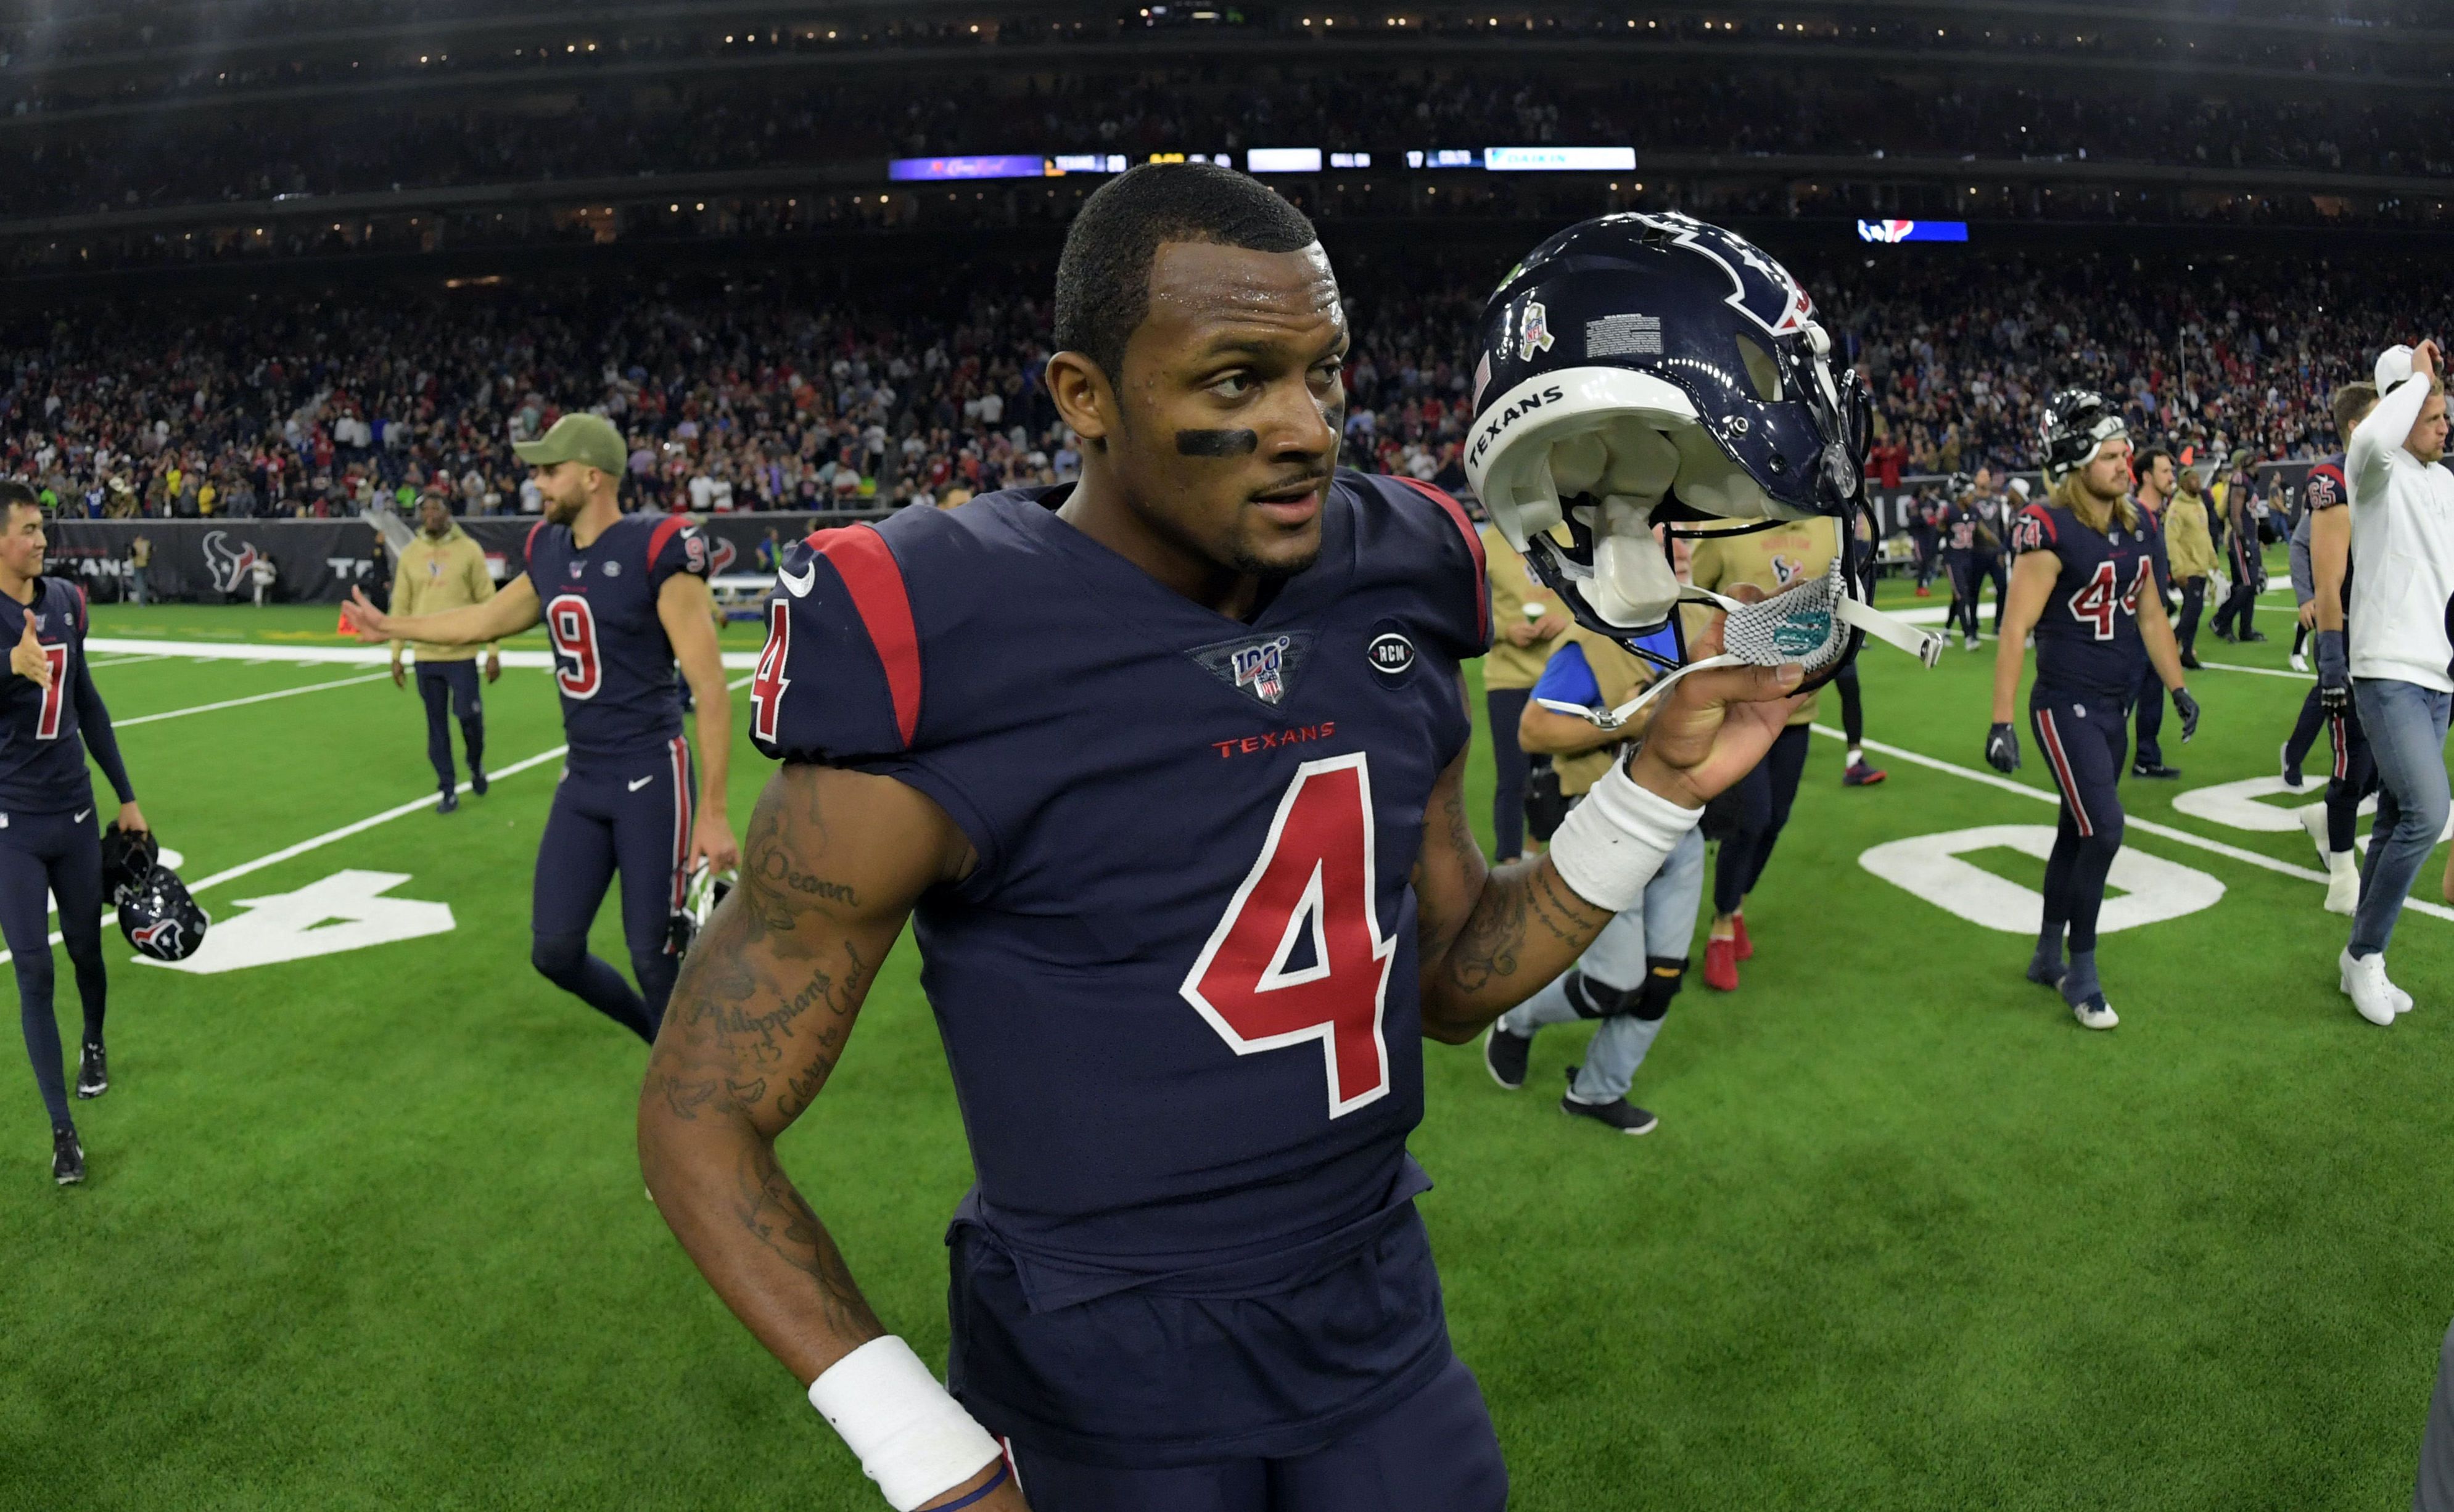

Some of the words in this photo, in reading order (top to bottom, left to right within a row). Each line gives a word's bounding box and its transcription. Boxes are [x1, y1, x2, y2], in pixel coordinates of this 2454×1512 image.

[1526, 325, 1542, 341] NFL
[1469, 385, 1564, 469] TEXANS
[2308, 479, 2337, 509] 65
[685, 536, 706, 573] 9
[546, 594, 602, 701] 9
[1378, 645, 1406, 663] RCM
[750, 598, 791, 744] 4
[1211, 721, 1335, 758] TEXANS
[1178, 750, 1398, 1120] 4
